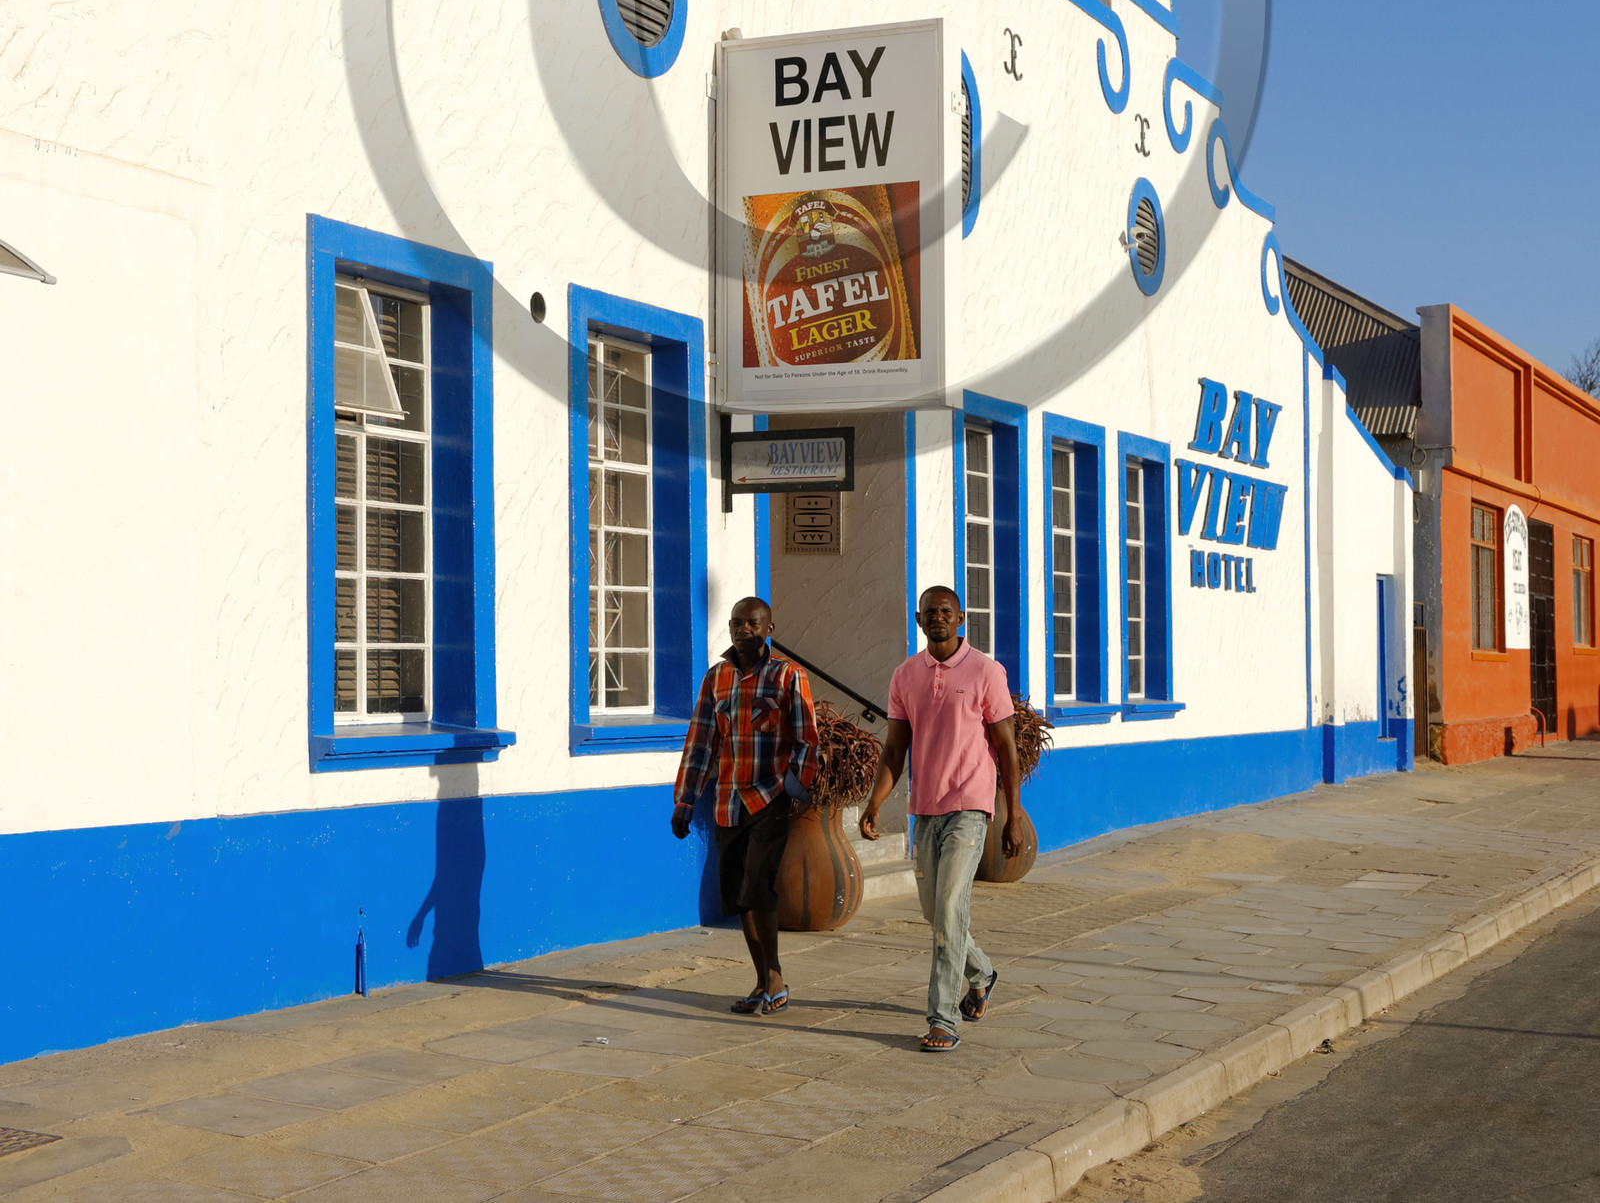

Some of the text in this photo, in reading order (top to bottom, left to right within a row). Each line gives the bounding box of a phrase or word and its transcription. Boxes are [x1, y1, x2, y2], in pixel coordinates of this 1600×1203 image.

[774, 46, 886, 107] BAY
[768, 110, 895, 175] VIEW
[795, 201, 826, 216] TAFEL
[795, 258, 850, 283] FINEST
[767, 271, 889, 329] TAFEL
[789, 309, 877, 350] LAGER
[794, 335, 876, 362] SUPERIOR TASTE
[1187, 377, 1282, 469] BAY
[770, 464, 840, 476] RESTAURANT
[1174, 458, 1288, 550] VIEW
[1190, 548, 1256, 593] HOTEL
